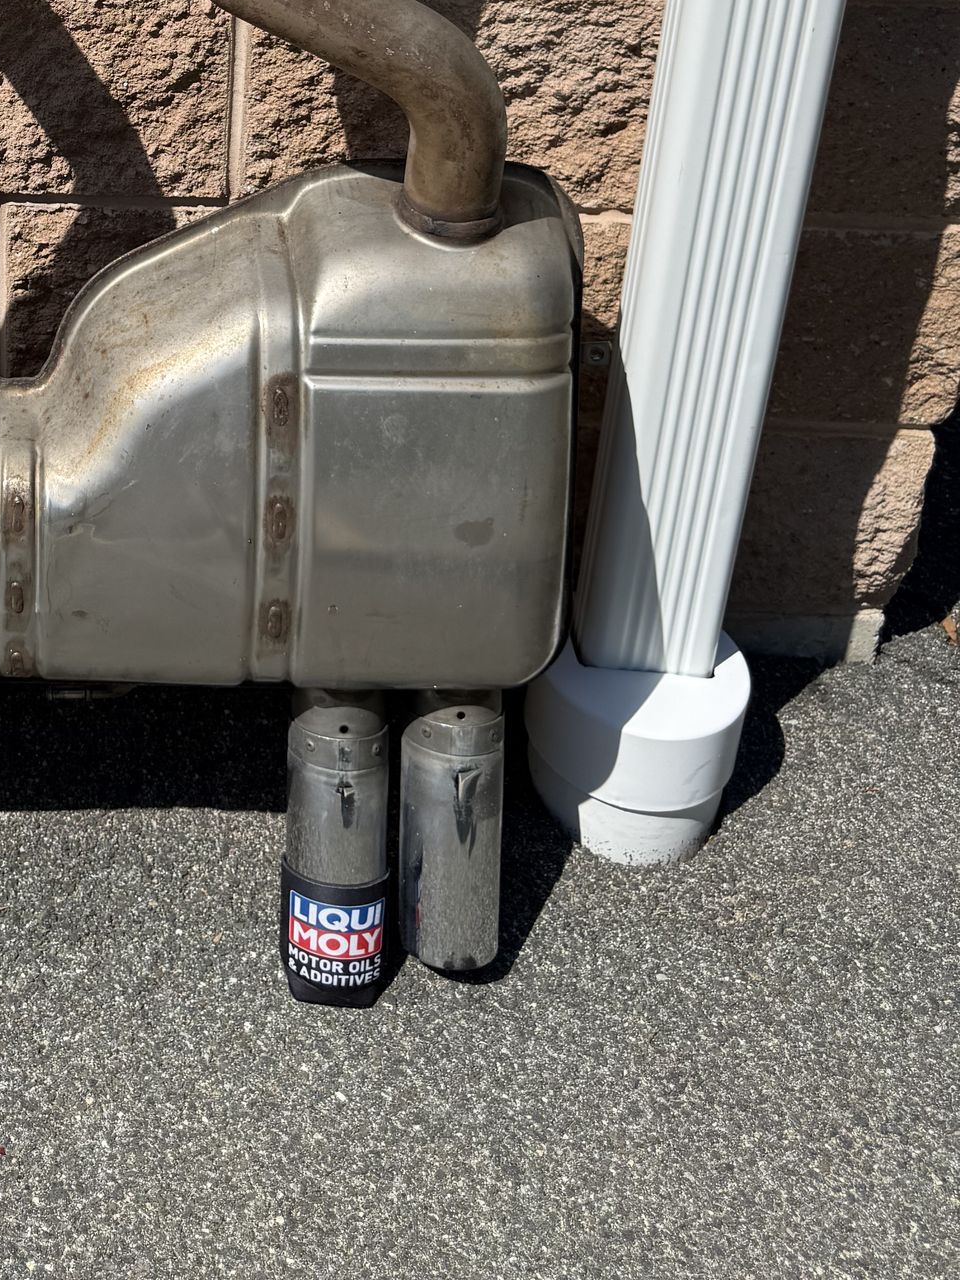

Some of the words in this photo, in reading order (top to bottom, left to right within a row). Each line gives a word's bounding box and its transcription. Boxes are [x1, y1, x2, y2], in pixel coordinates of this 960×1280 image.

[293, 895, 382, 933] LIQUI
[293, 920, 381, 957] MOLY
[288, 942, 344, 974] MOTOR
[348, 953, 381, 974] OILS
[288, 957, 298, 973] &
[299, 966, 381, 987] ADDITIVES
